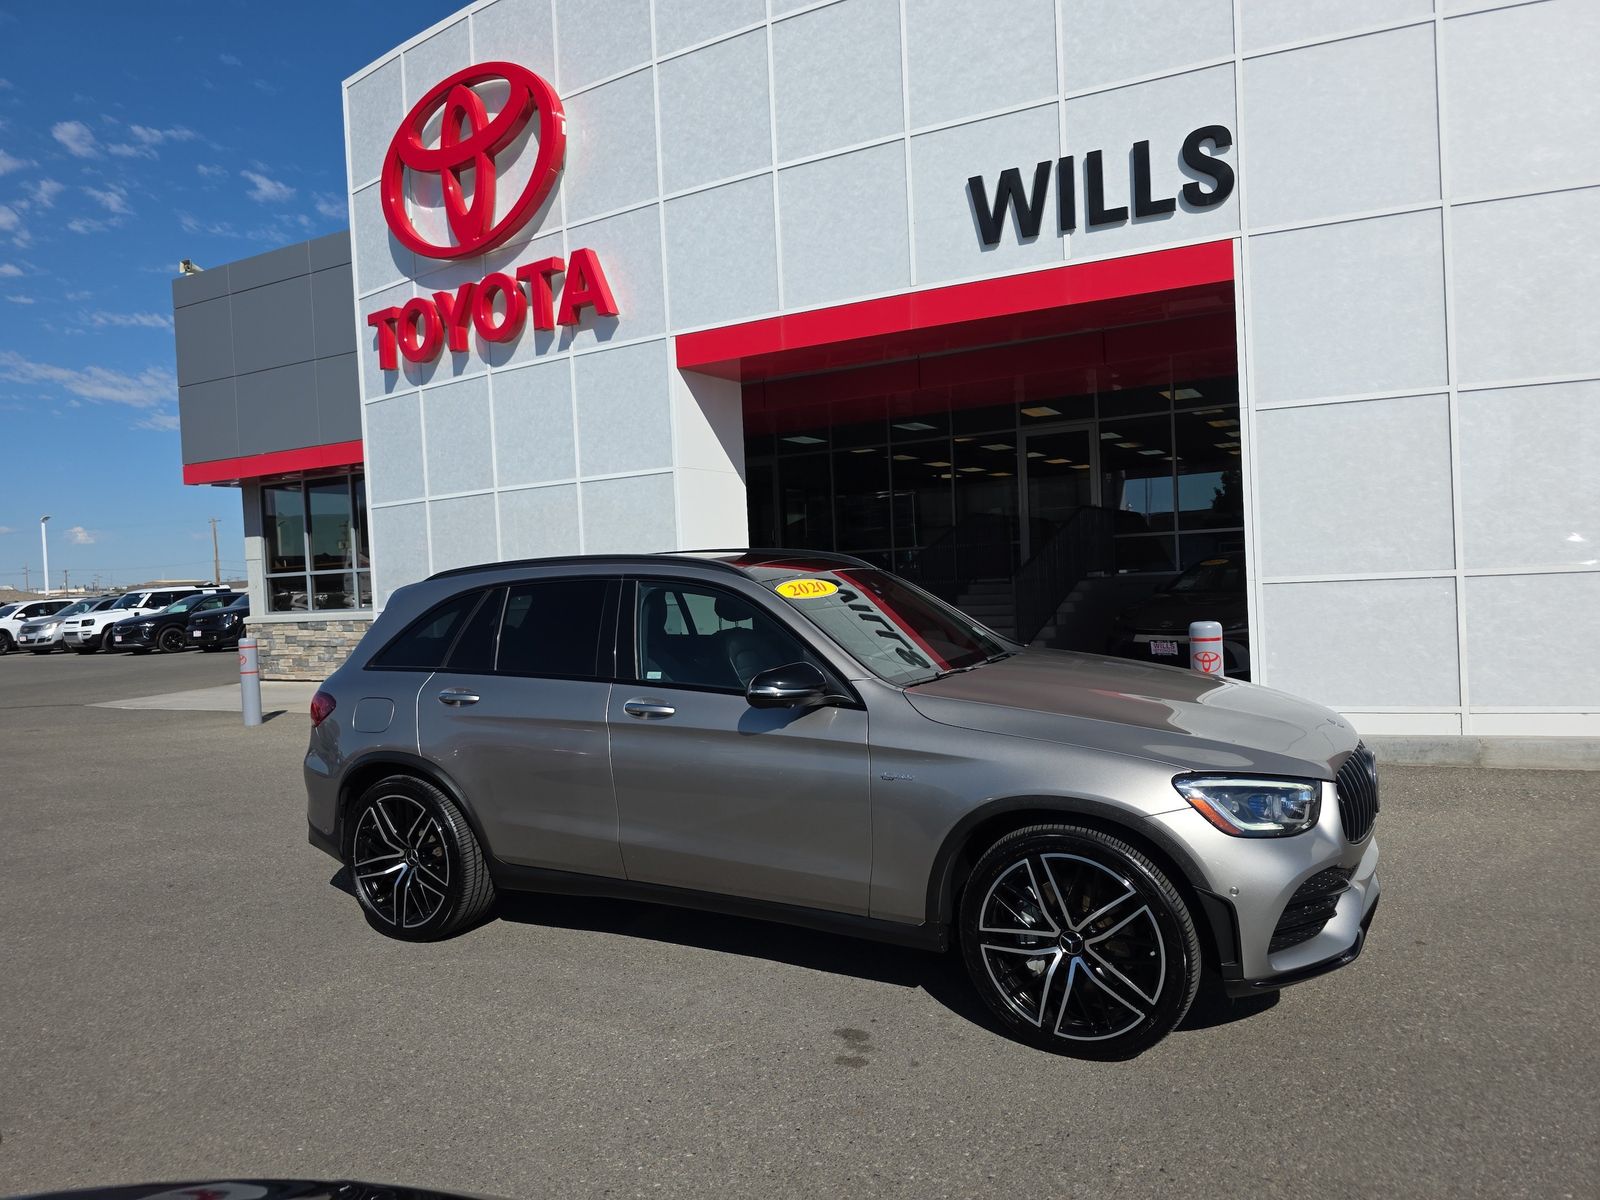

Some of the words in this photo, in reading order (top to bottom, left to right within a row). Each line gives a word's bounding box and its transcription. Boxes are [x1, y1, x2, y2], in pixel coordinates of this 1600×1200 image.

[968, 125, 1235, 245] WILLS
[368, 248, 620, 371] TOYOTA
[787, 581, 827, 597] 2020
